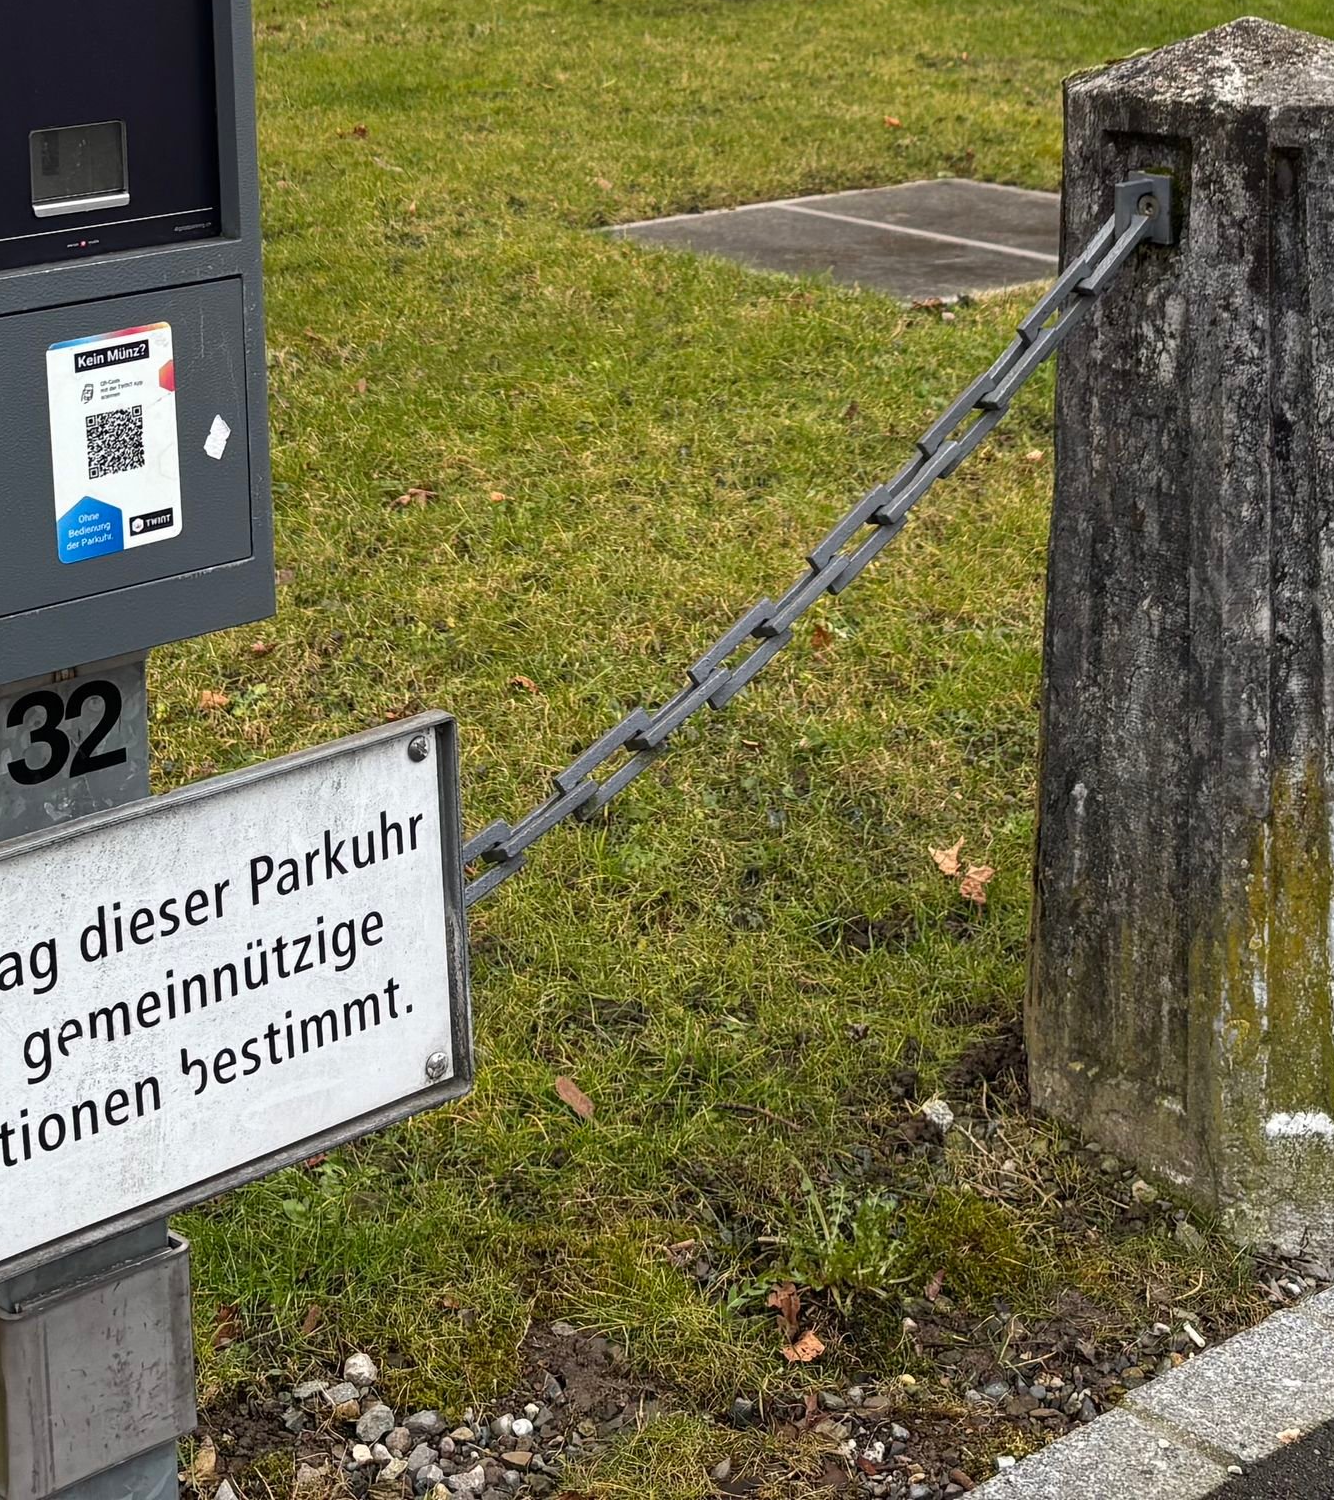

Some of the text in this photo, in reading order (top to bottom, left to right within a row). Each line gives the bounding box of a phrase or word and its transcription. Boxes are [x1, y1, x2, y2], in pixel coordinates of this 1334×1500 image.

[77, 343, 146, 368] Kein Münz?
[68, 522, 111, 538] Bedienung
[78, 513, 100, 523] Ohne
[145, 514, 171, 528] TWINT
[66, 533, 114, 551] der Parkuhr.
[6, 680, 127, 786] 32
[80, 879, 230, 963] dieser
[250, 810, 423, 906] Parkuhr
[23, 910, 384, 1085] gemeinnützige
[180, 977, 413, 1096] bestimmt.
